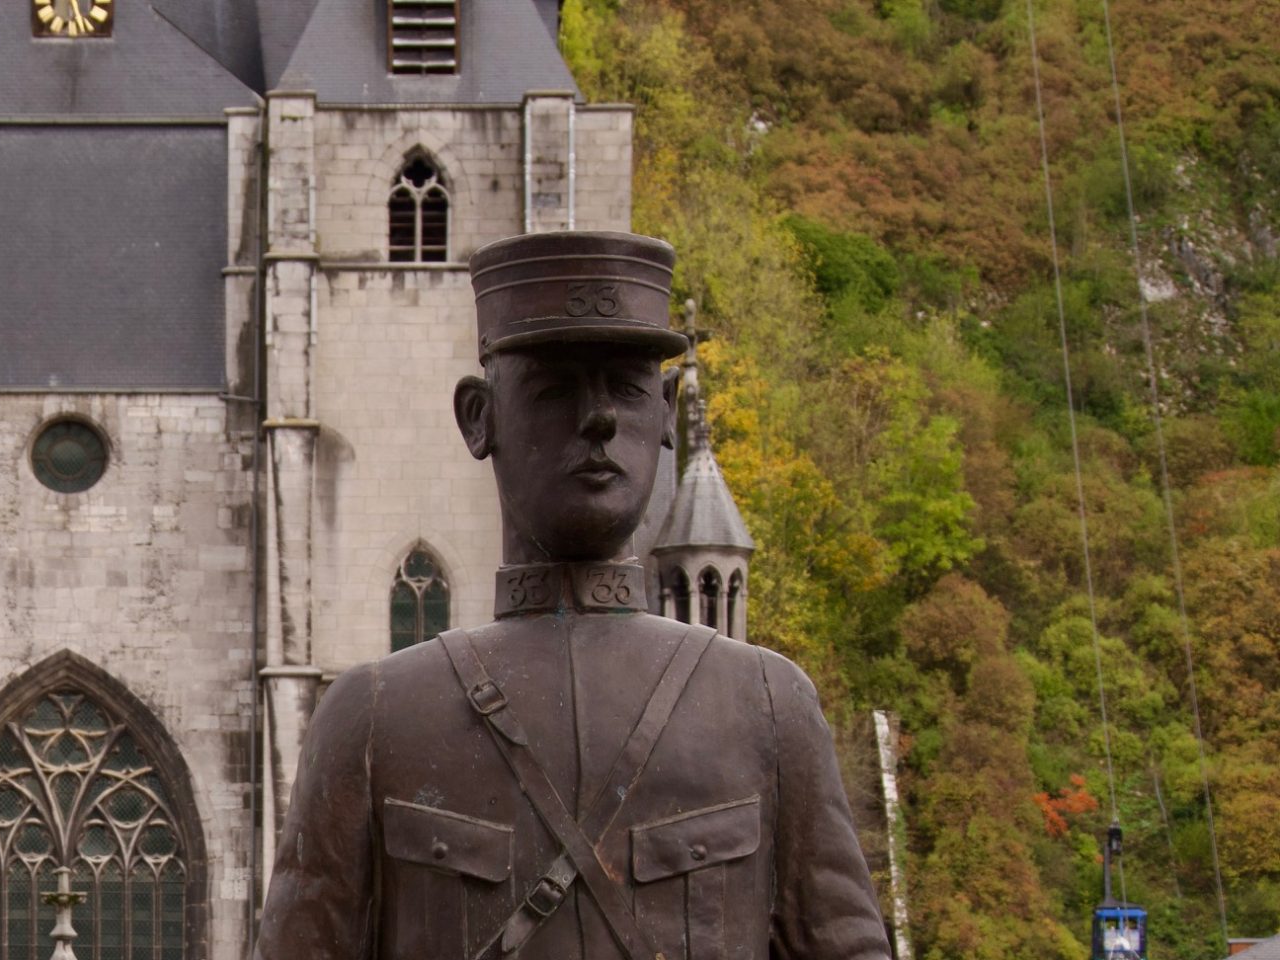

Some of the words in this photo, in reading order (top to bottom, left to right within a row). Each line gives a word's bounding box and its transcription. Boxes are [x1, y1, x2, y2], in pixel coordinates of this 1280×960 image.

[565, 282, 621, 318] 33
[506, 568, 552, 608] 33
[587, 569, 631, 605] 33
